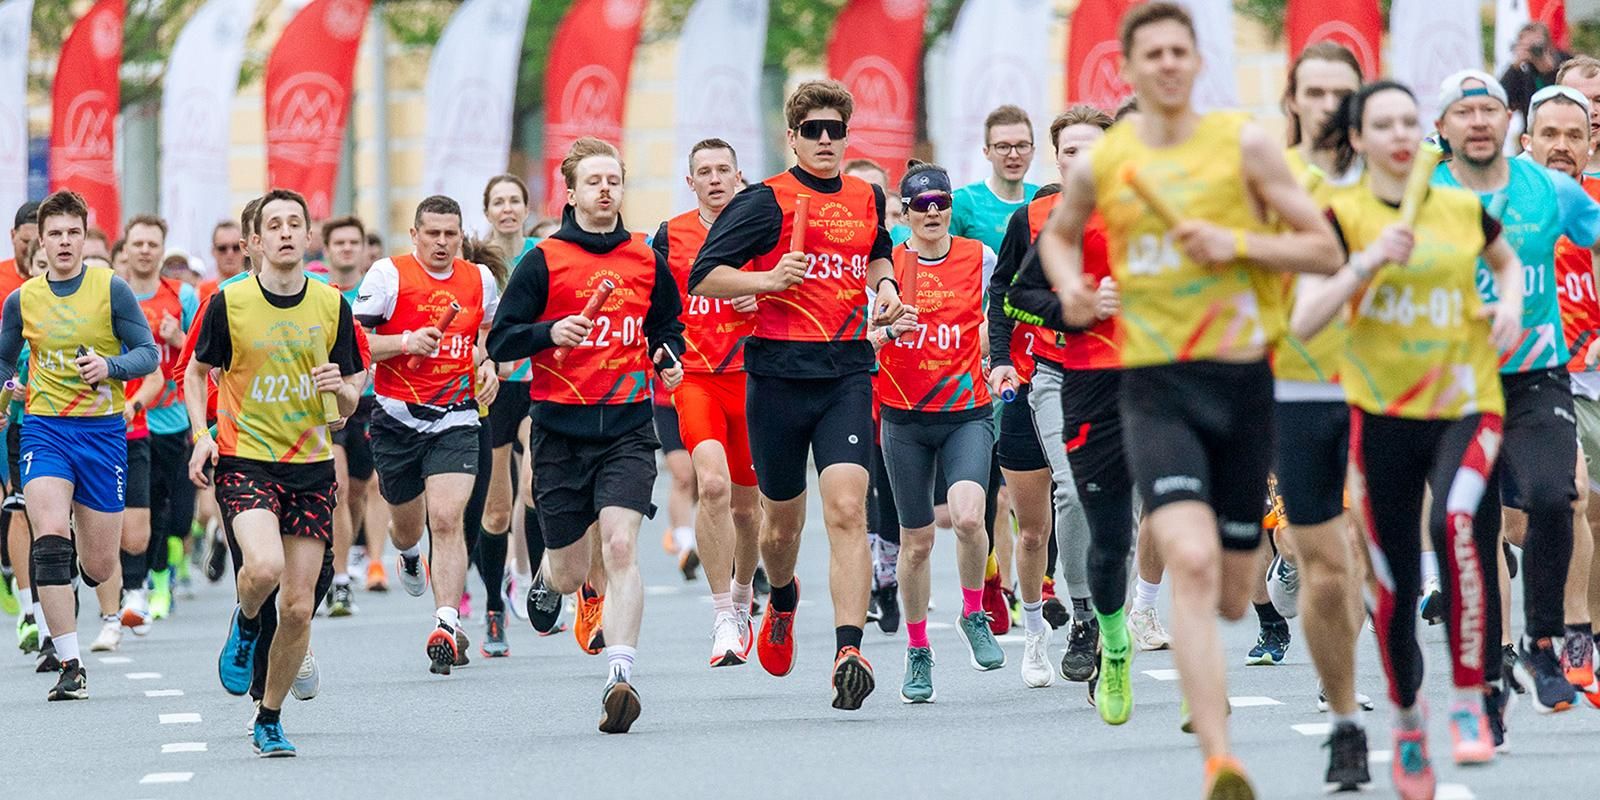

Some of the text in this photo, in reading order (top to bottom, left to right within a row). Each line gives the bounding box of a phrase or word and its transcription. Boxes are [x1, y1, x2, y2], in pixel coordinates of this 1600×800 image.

[819, 202, 853, 217] САДОВОЕ
[809, 219, 866, 228] ЭСТАФЕТА
[824, 230, 855, 243] КОЛЬЦО
[804, 253, 868, 279] 233-01
[587, 270, 625, 287] САДОВОЕ
[917, 272, 943, 288] ДОВОЕ
[575, 288, 635, 298] ЭСТФЕТА
[916, 290, 956, 298] АФЕТА
[600, 299, 625, 312] ЛЬЦО
[687, 293, 731, 315] 261-
[580, 316, 643, 347] 22-01
[894, 323, 960, 350] 7-01
